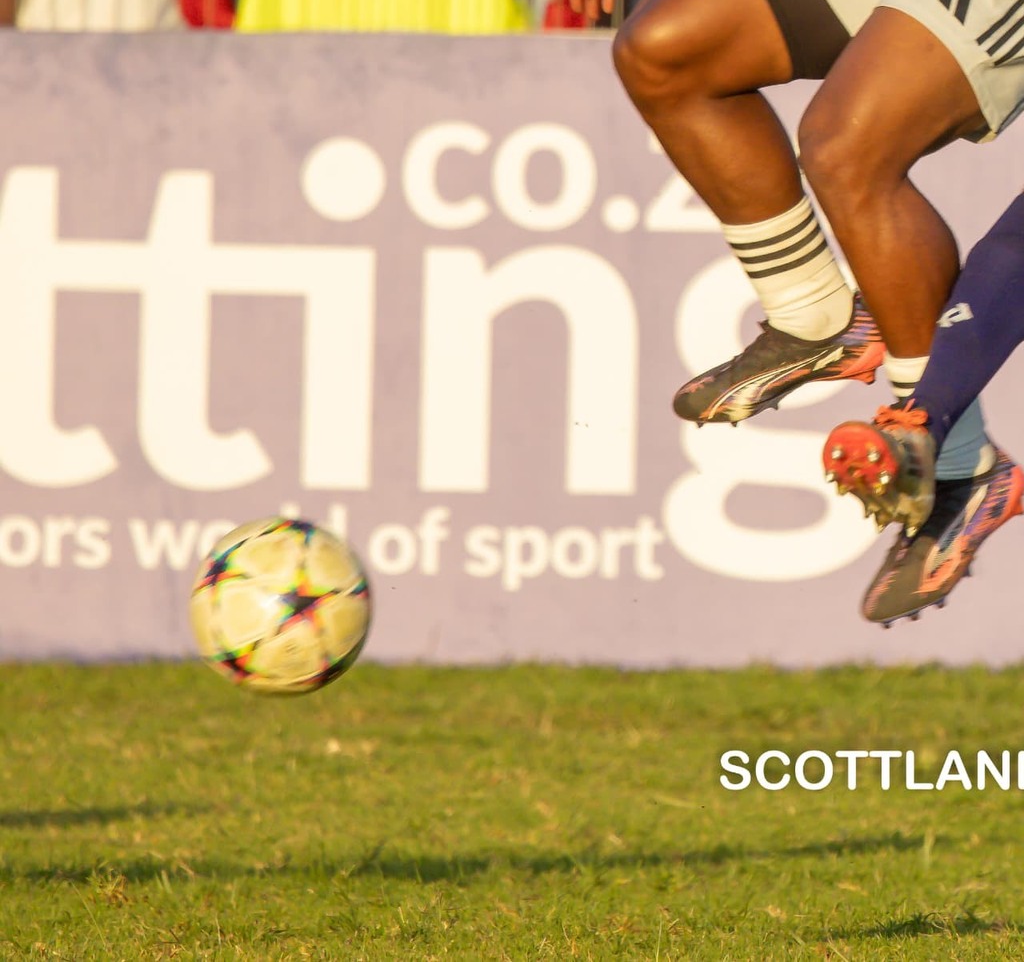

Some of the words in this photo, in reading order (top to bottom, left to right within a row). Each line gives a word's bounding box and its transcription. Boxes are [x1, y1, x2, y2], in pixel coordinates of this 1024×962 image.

[0, 513, 113, 570] ors
[369, 505, 452, 577] of
[463, 515, 666, 593] sport
